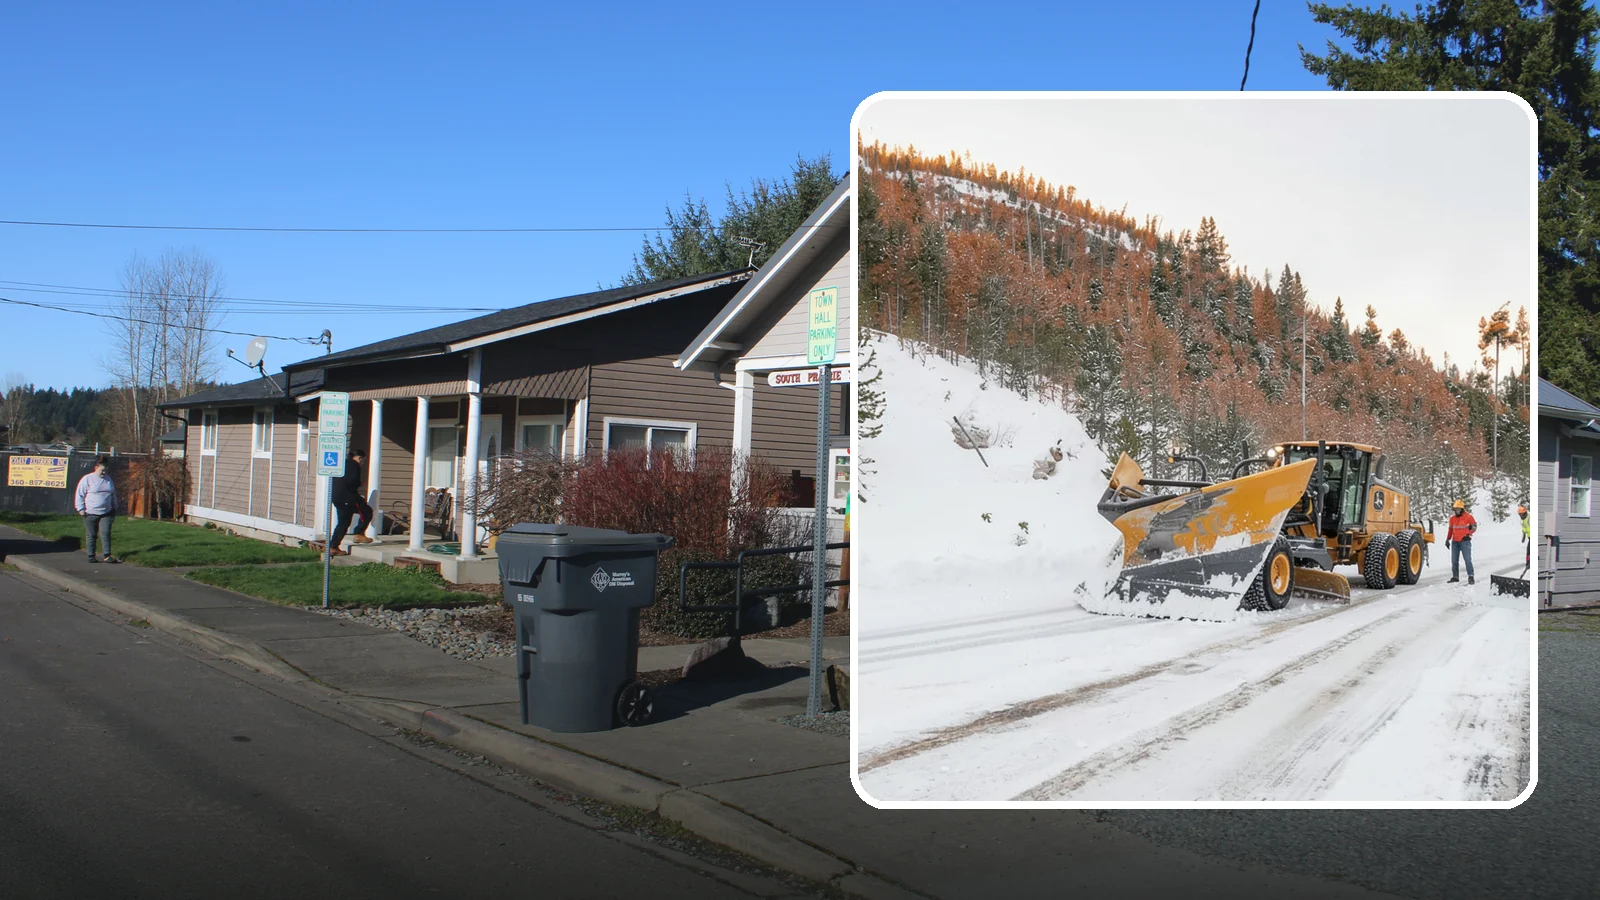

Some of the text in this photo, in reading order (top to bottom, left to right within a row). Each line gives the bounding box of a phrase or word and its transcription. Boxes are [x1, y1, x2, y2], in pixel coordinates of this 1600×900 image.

[815, 295, 832, 307] TOWN
[815, 312, 831, 324] HALL
[810, 327, 835, 340] PARKING
[814, 344, 831, 357] ONLY
[775, 373, 801, 384] SOUTH
[808, 371, 841, 382] PRIE
